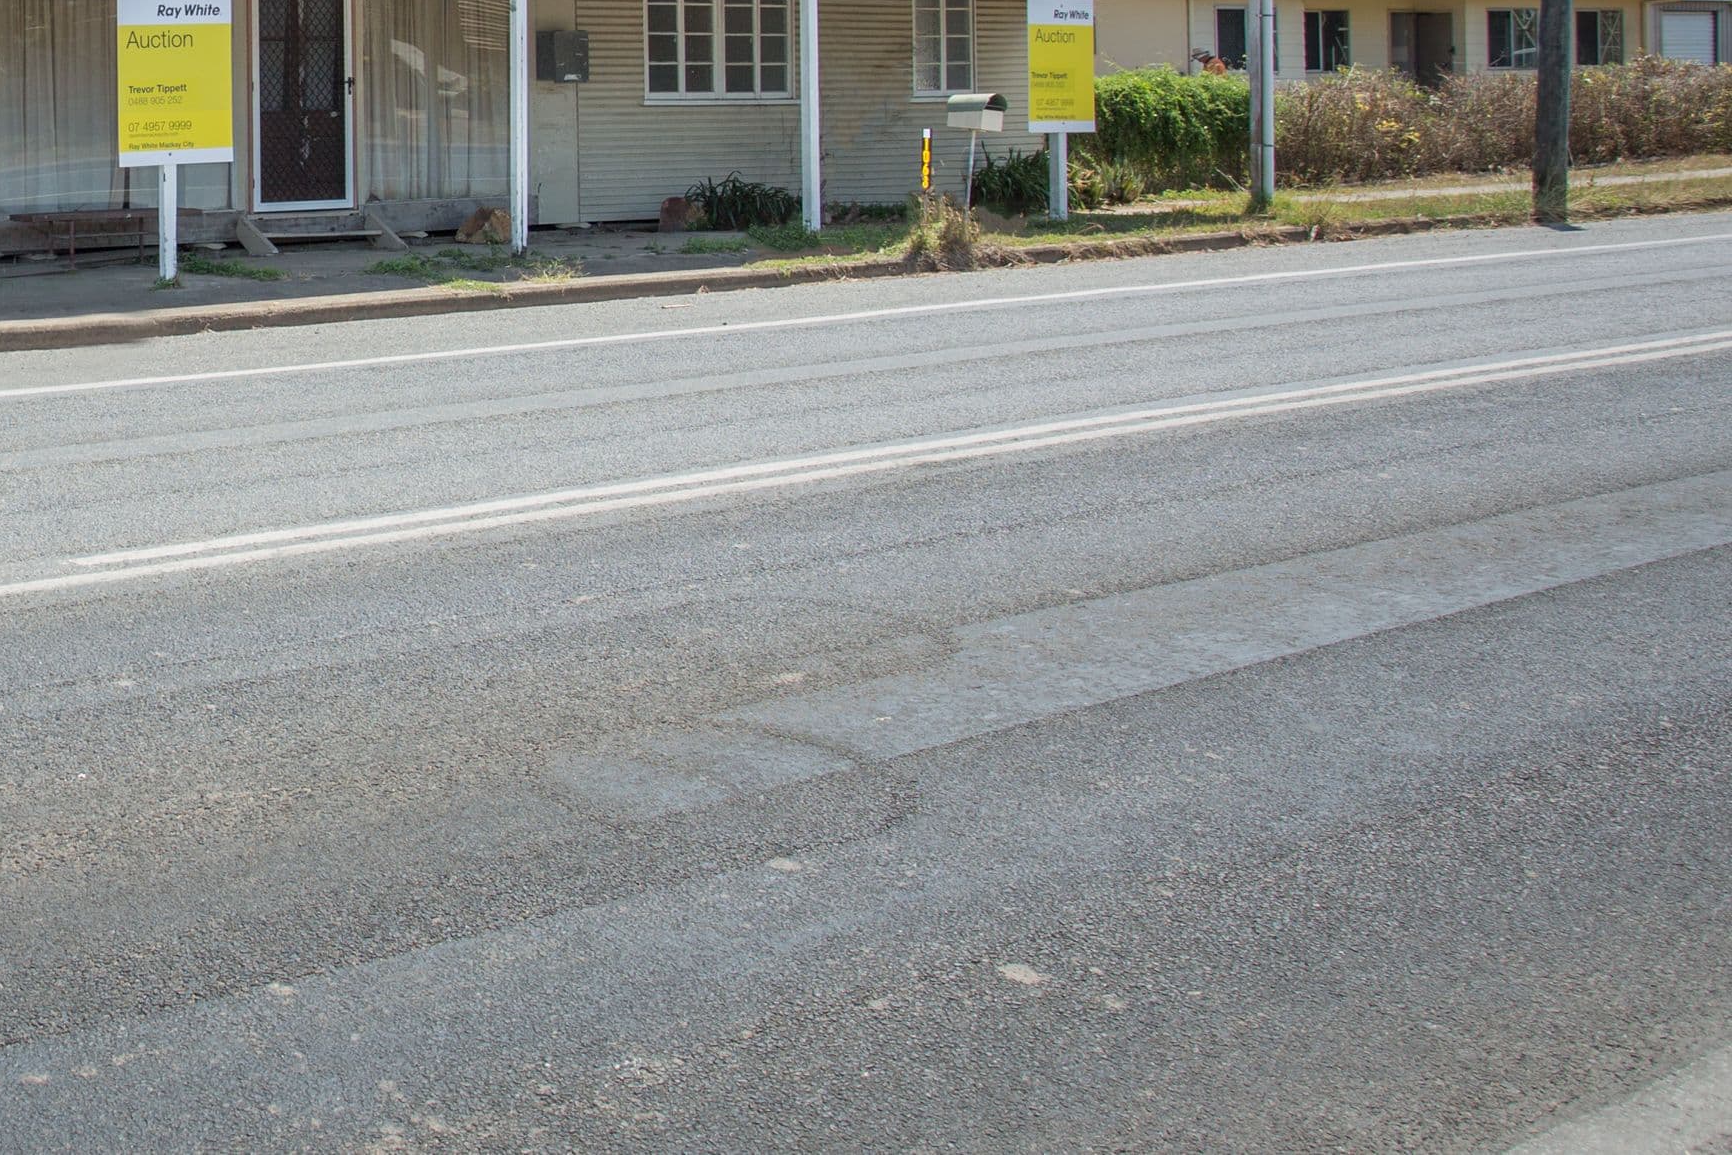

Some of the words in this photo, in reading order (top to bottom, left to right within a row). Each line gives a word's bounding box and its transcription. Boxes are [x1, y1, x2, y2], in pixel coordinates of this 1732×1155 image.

[157, 4, 182, 19] Ray
[184, 4, 221, 16] White
[1053, 9, 1068, 21] Ray
[1069, 9, 1090, 20] White
[126, 30, 194, 49] Auction
[1035, 28, 1076, 44] Auction
[128, 85, 154, 94] Trevor
[156, 84, 187, 94] Tippett
[128, 122, 139, 133] 07
[142, 121, 166, 132] 4957
[168, 120, 193, 131] 9999
